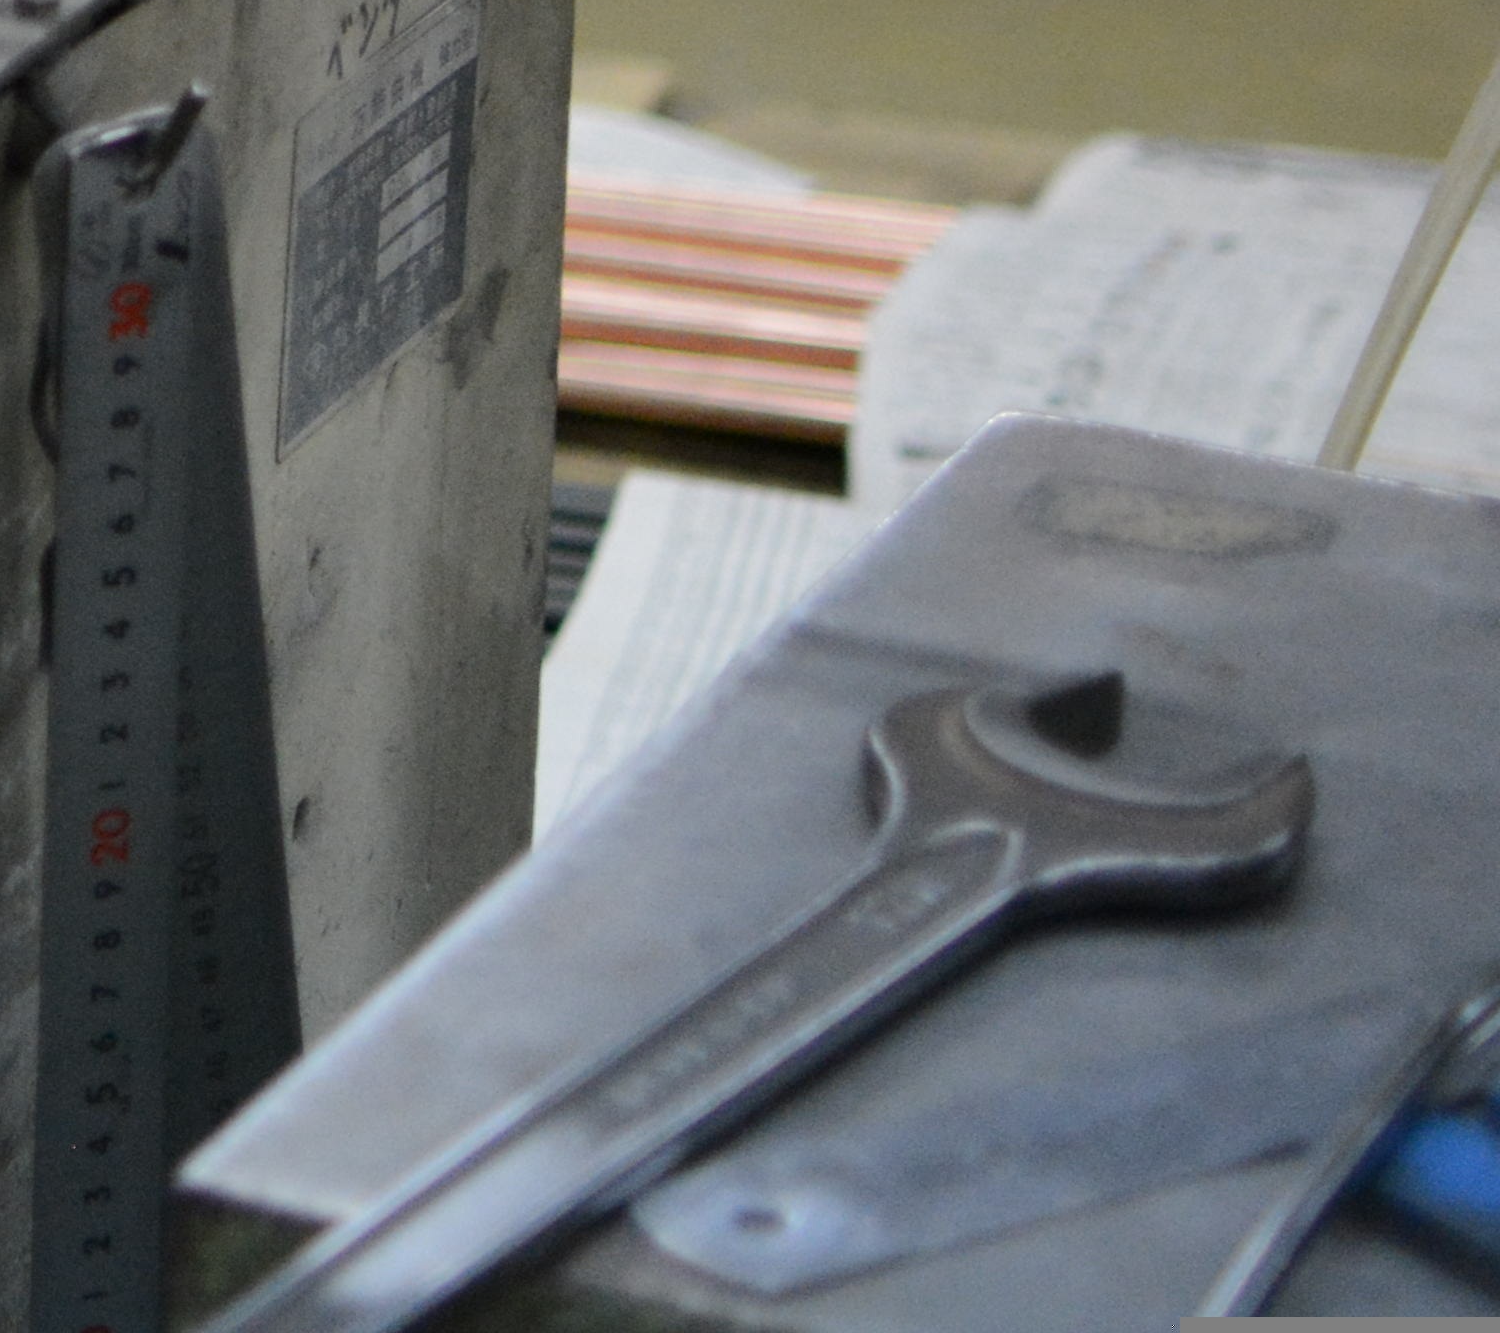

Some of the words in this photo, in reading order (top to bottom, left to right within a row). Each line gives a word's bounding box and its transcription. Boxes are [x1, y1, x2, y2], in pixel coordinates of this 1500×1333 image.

[108, 279, 151, 342] 30
[113, 354, 142, 378] 9
[109, 407, 141, 430] 8
[108, 462, 137, 482] 7
[110, 512, 136, 535] 6
[103, 566, 136, 589] 5
[104, 617, 130, 640] 4
[103, 670, 131, 692] 3
[101, 723, 128, 745] 2
[88, 807, 132, 867] 20
[94, 878, 121, 901] 9
[93, 928, 122, 951] 8
